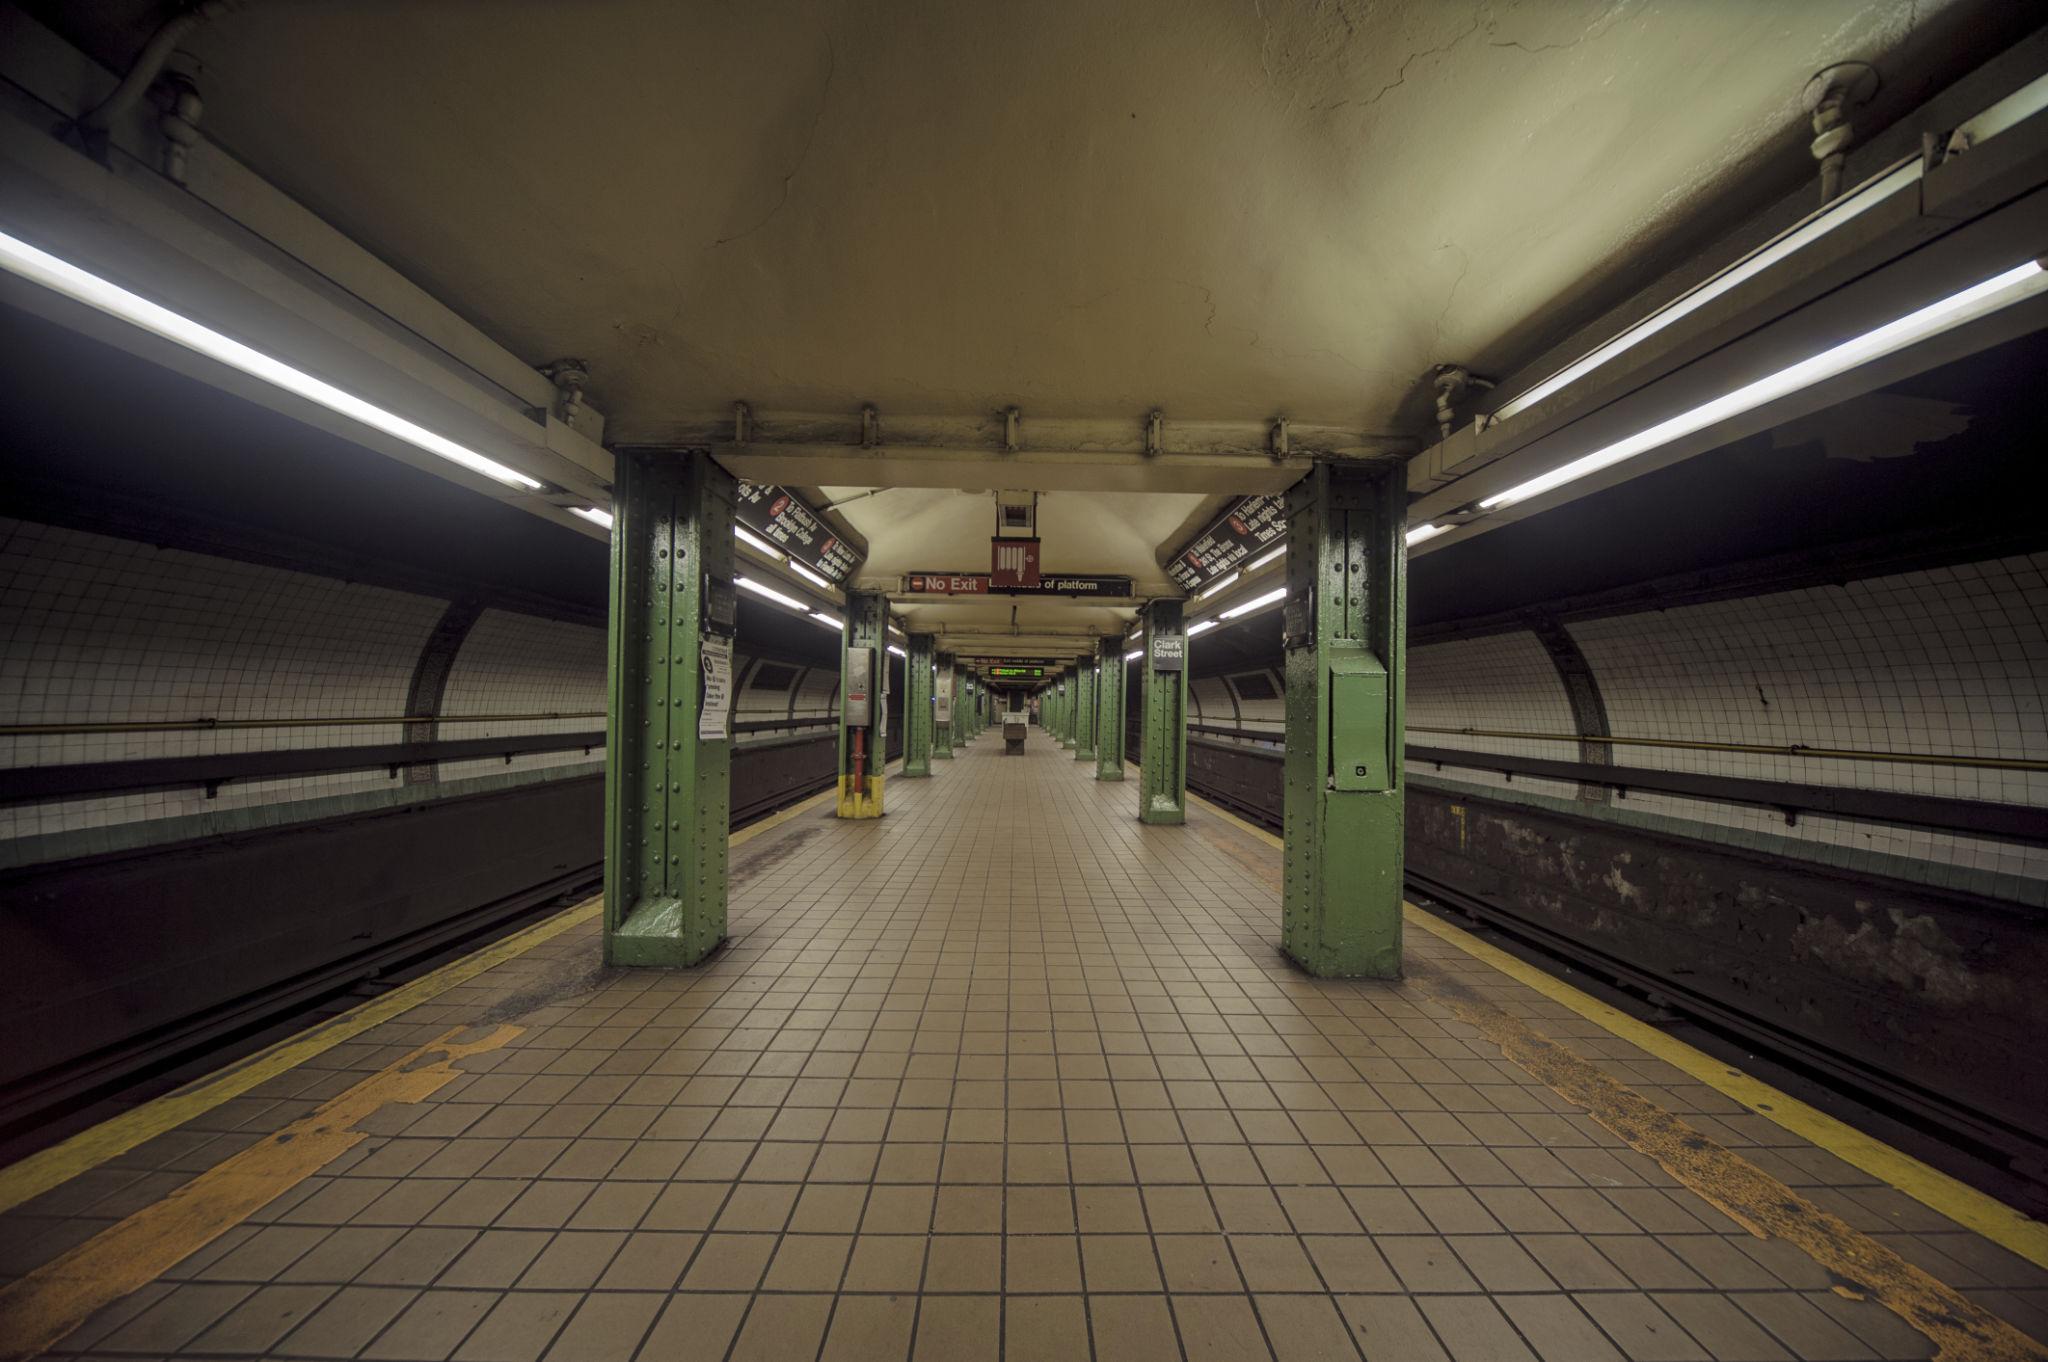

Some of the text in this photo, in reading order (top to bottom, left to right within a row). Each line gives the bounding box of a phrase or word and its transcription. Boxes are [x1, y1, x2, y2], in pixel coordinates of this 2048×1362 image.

[791, 506, 814, 528] Flatbush
[1244, 518, 1260, 531] Late
[1255, 503, 1279, 524] nights
[775, 511, 814, 545] Brooklyn College
[1254, 525, 1276, 543] Times
[1233, 544, 1248, 557] local
[926, 577, 946, 590] No
[951, 578, 978, 590] Exit
[1044, 580, 1054, 588] of
[1058, 580, 1097, 590] platform
[1154, 640, 1181, 649] Clark
[1154, 649, 1183, 658] Street
